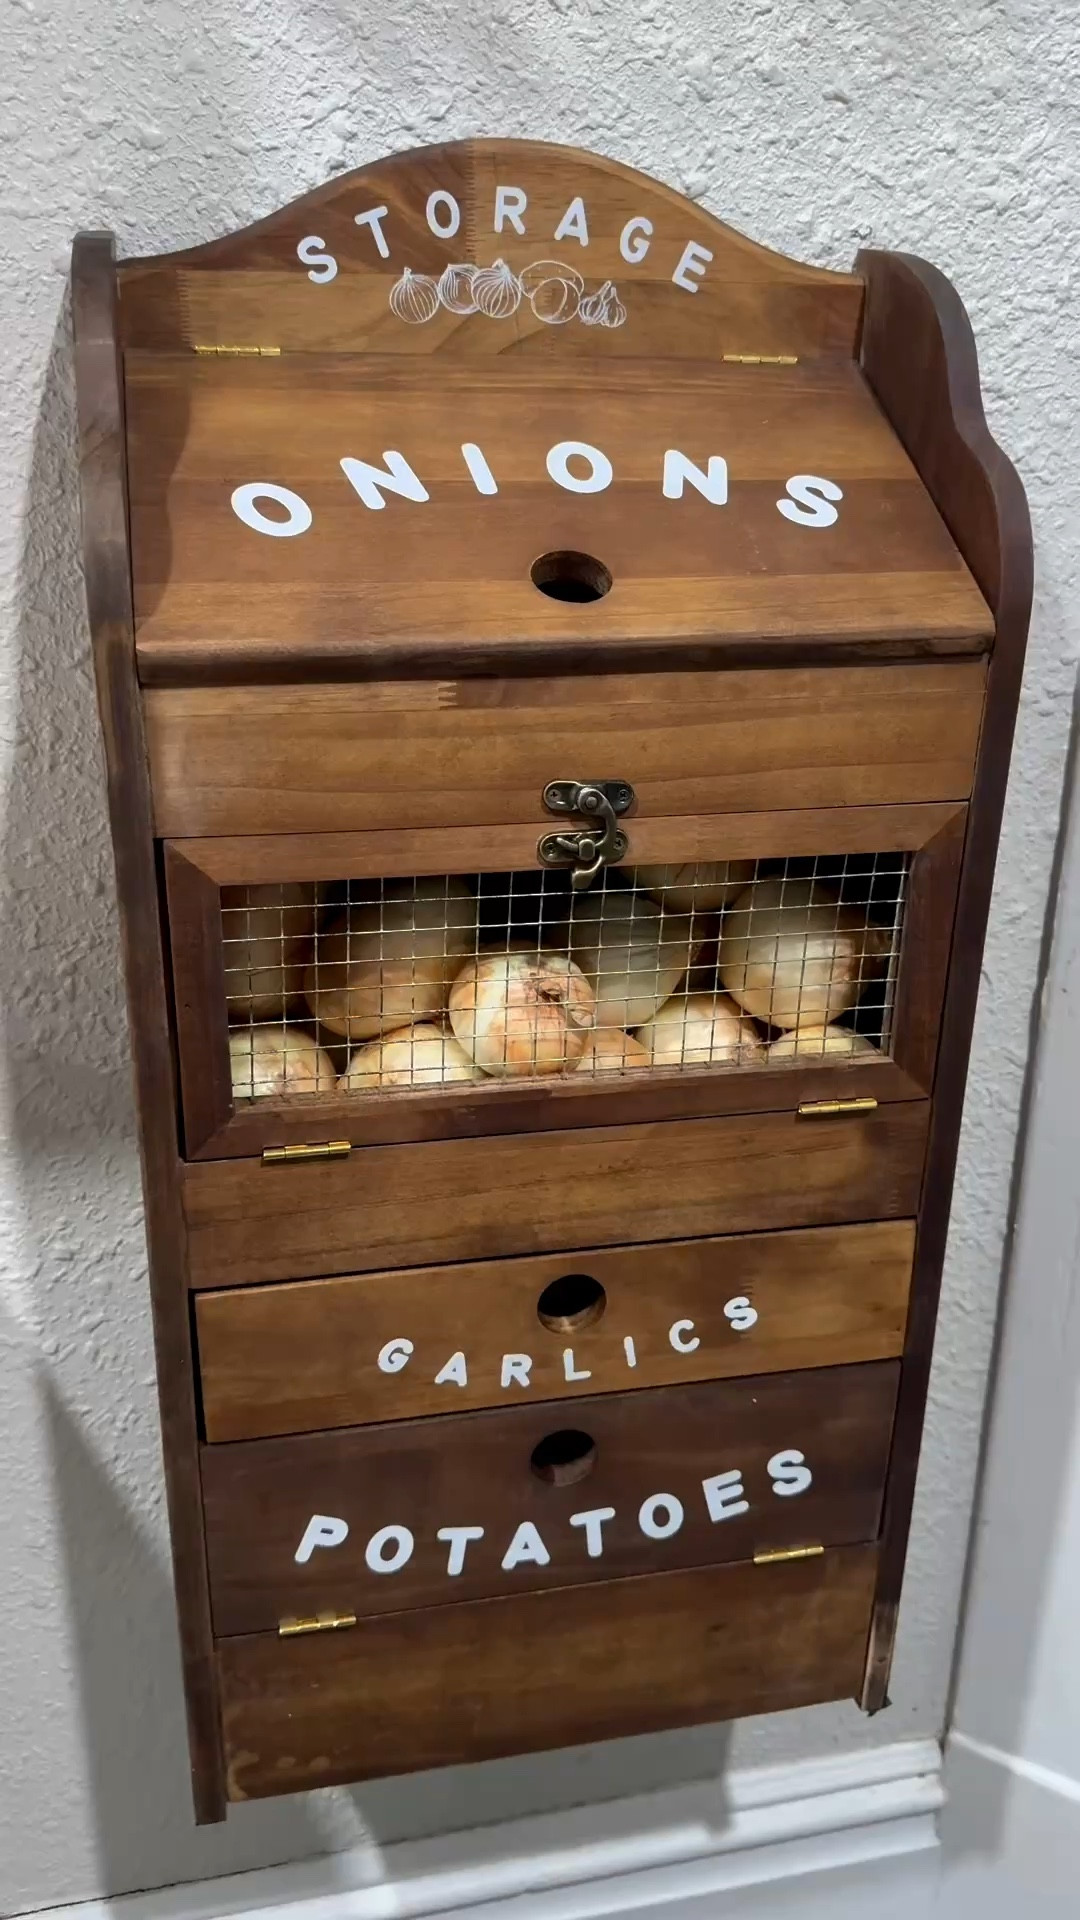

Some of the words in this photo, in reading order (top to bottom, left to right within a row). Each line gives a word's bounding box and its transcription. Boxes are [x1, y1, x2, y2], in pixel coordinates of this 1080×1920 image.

[296, 185, 714, 294] STORAGE
[230, 440, 844, 539] ONIONS
[377, 1296, 760, 1388] GARLICS
[294, 1449, 812, 1576] POTATOES
